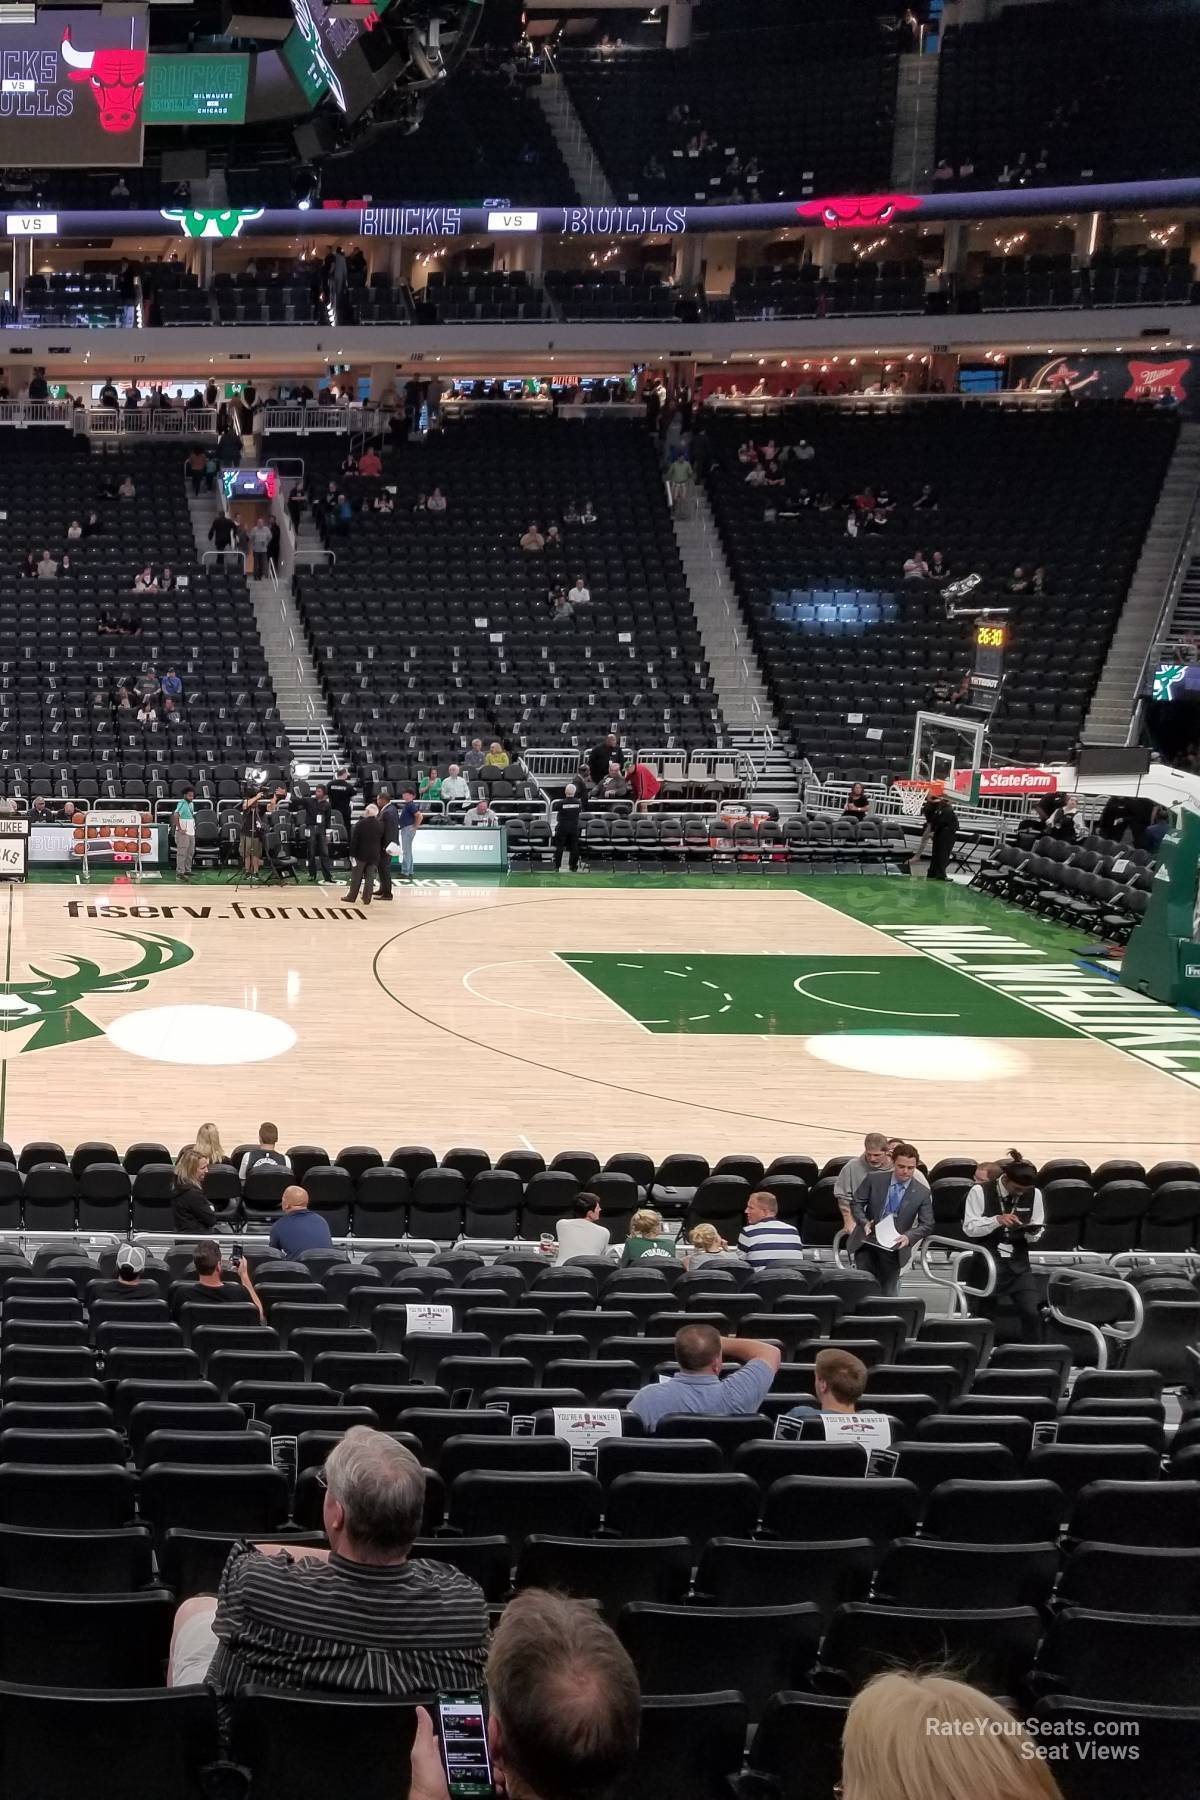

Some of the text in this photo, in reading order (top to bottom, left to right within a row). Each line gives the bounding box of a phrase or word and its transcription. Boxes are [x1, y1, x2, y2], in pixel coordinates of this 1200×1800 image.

[11, 81, 25, 90] VS
[22, 218, 41, 230] VS
[360, 207, 687, 235] BUCKS VS BULLS
[133, 355, 146, 363] 117
[1140, 368, 1176, 385] Miller
[1135, 385, 1156, 393] HIH
[977, 628, 1003, 646] 26:30
